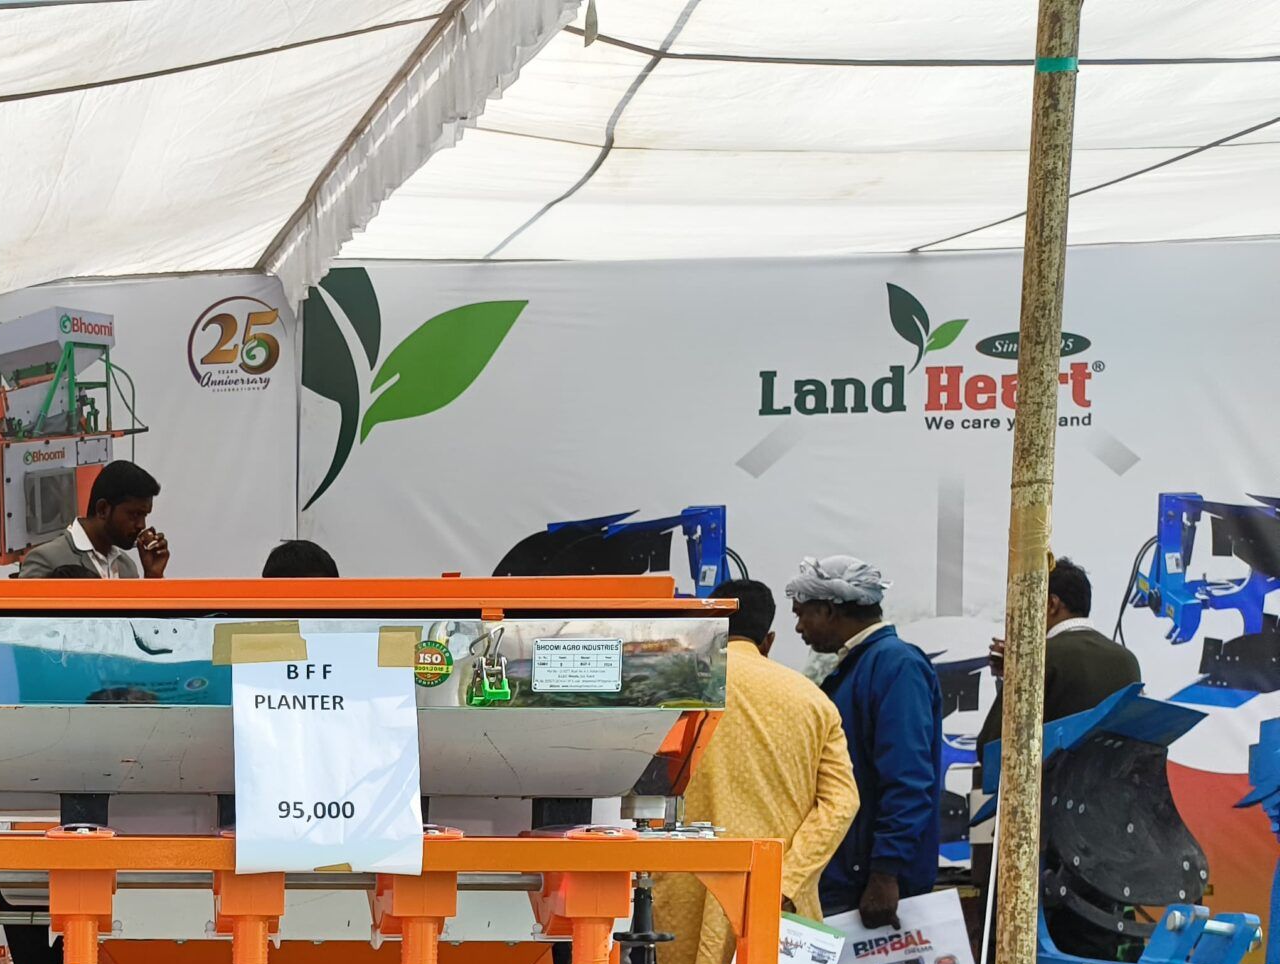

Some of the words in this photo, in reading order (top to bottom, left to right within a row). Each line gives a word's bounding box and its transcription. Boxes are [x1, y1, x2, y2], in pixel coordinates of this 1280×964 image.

[71, 318, 113, 337] Bhoomi
[200, 308, 280, 375] 25
[200, 371, 271, 390] Anniversary
[758, 365, 906, 416] Land
[924, 416, 955, 431] We
[961, 417, 1001, 430] care
[32, 447, 66, 463] Bhoomi
[418, 653, 442, 664] ISO
[254, 694, 345, 711] PLANTER
[277, 800, 356, 822] 95,000
[852, 930, 932, 960] BIRBAL
